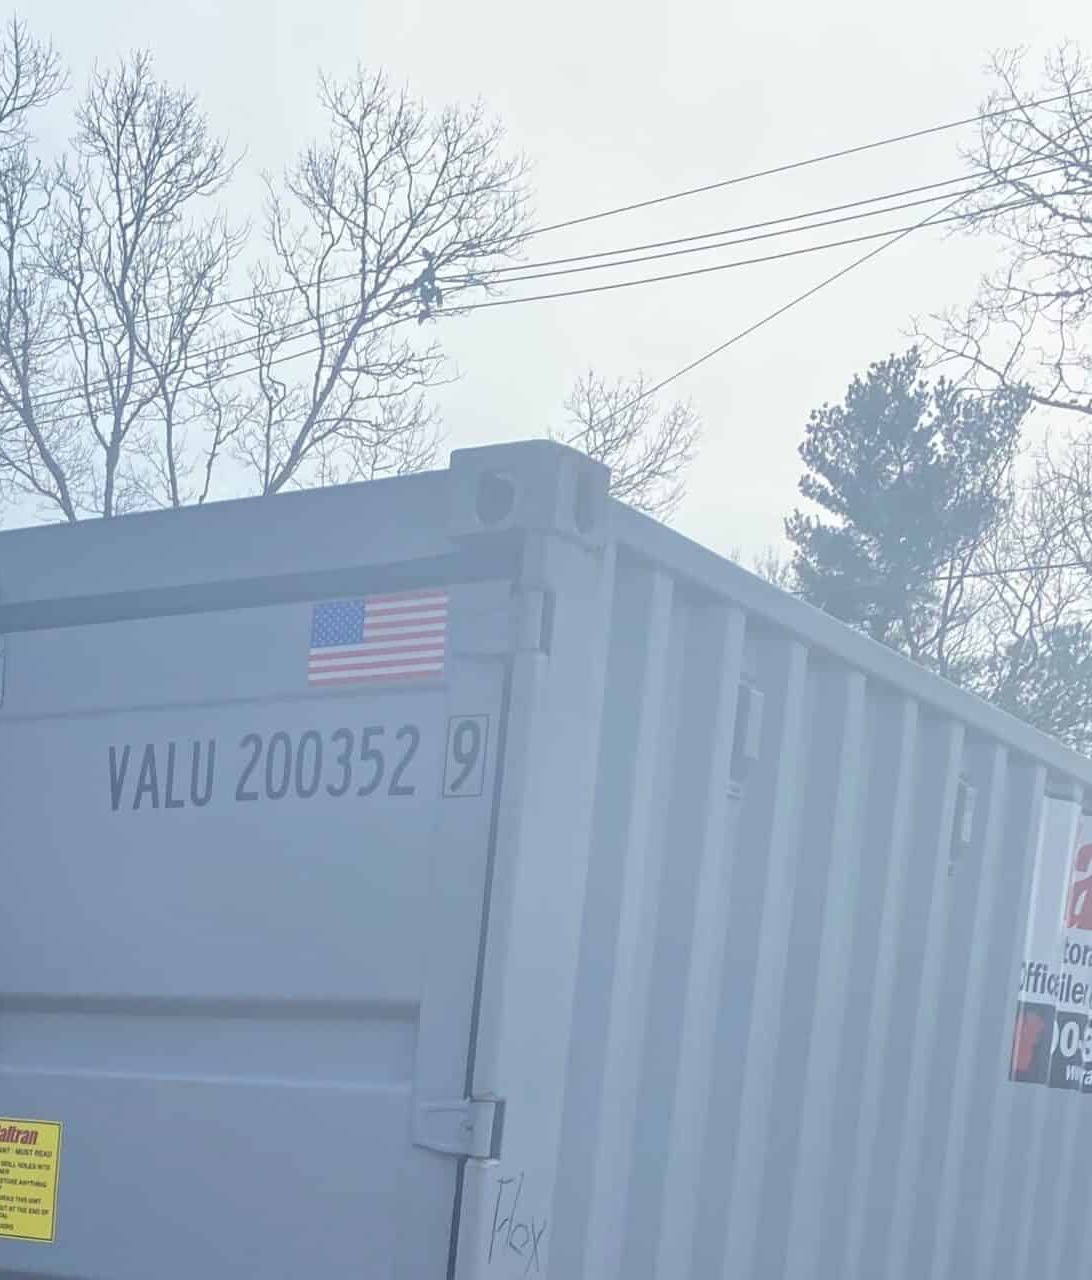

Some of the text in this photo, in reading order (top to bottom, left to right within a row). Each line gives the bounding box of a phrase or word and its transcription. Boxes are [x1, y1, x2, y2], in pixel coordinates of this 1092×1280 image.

[108, 719, 481, 811] VALU 200352 9
